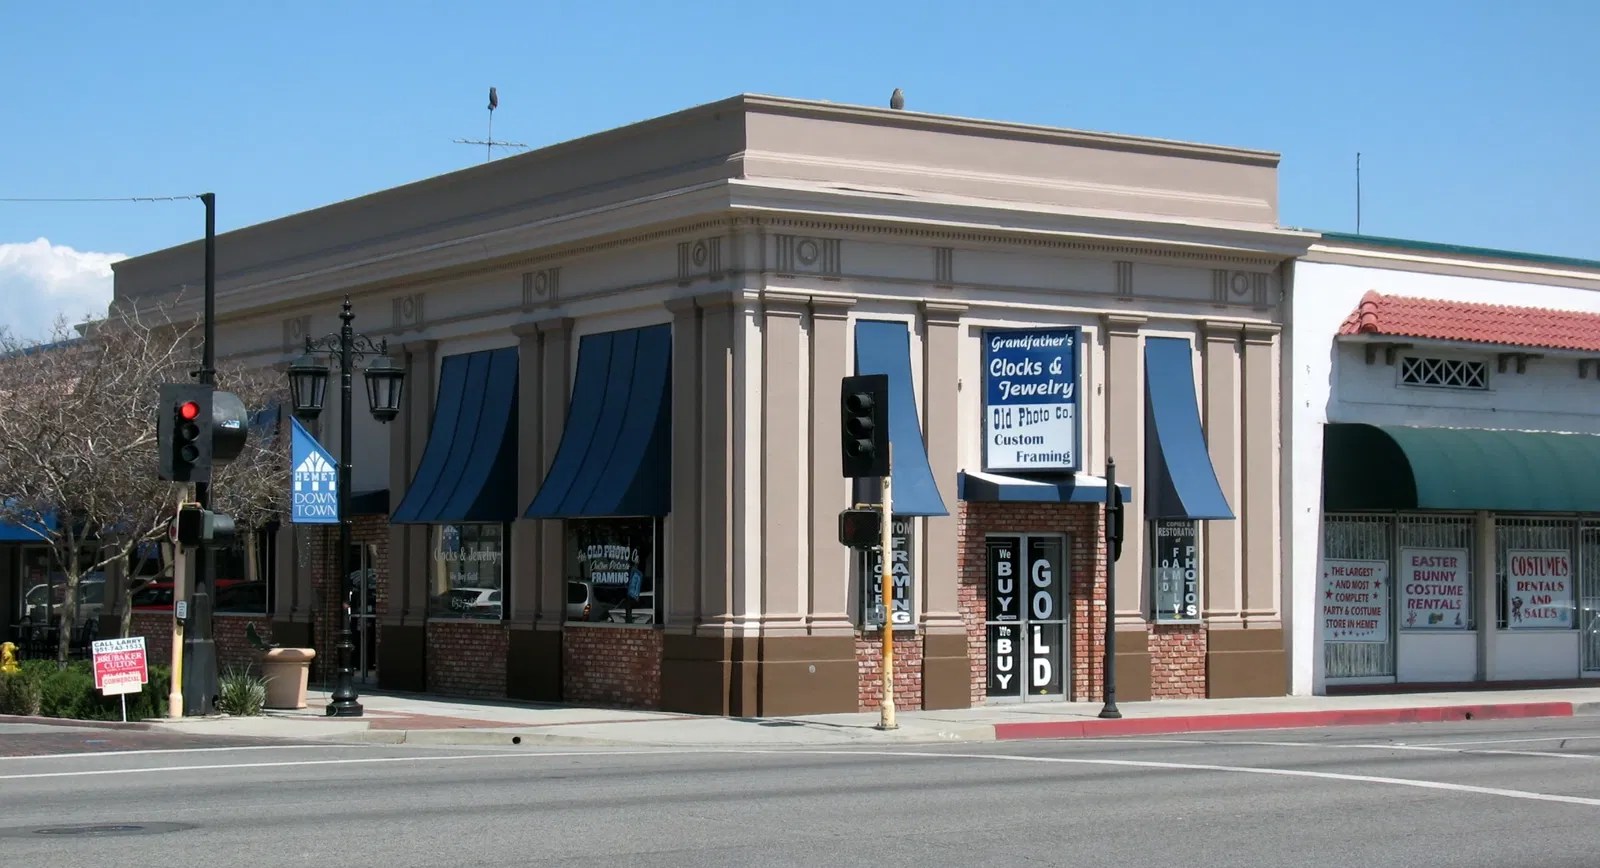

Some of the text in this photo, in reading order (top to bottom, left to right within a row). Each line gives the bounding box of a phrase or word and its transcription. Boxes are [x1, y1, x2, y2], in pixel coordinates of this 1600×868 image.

[992, 334, 1073, 352] Grandfather's
[990, 357, 1062, 377] Clocks &
[998, 380, 1074, 400] Jewelry
[994, 406, 1072, 430] Old Photo Co.
[994, 434, 1044, 446] Custom
[1016, 450, 1071, 464] Framing
[295, 472, 335, 481] HEMET
[295, 493, 336, 504] DOWN
[296, 505, 336, 516] TOWN
[460, 547, 466, 561] &
[469, 548, 497, 564] Jewelry
[587, 545, 602, 559] OLD
[604, 545, 630, 561] PHOTO
[999, 548, 1011, 559] We
[1412, 556, 1457, 568] EASTER
[1511, 556, 1568, 577] COSTUMES
[592, 572, 629, 584] FRAMING
[1332, 567, 1374, 577] THE LARGEST
[1413, 571, 1456, 582] BUNNY
[892, 537, 910, 623] FRAMING
[1172, 547, 1180, 614] FAMILY
[1185, 546, 1197, 616] PHOTOS
[1336, 580, 1369, 590] AND MOST
[997, 562, 1013, 612] BUY
[1406, 584, 1463, 596] COSTUME
[1517, 581, 1564, 592] RENTALS
[1335, 593, 1369, 603] COMPLETE
[1530, 595, 1551, 605] AND
[1407, 599, 1461, 610] RENTALS
[1324, 606, 1381, 616] PARTY & COSTUME
[1524, 607, 1558, 618] SALES
[1032, 559, 1052, 687] GOLD
[1326, 619, 1378, 628] STORE IN HEMET
[998, 626, 1012, 636] We
[104, 661, 136, 669] CULTON
[996, 639, 1013, 689] BUY
